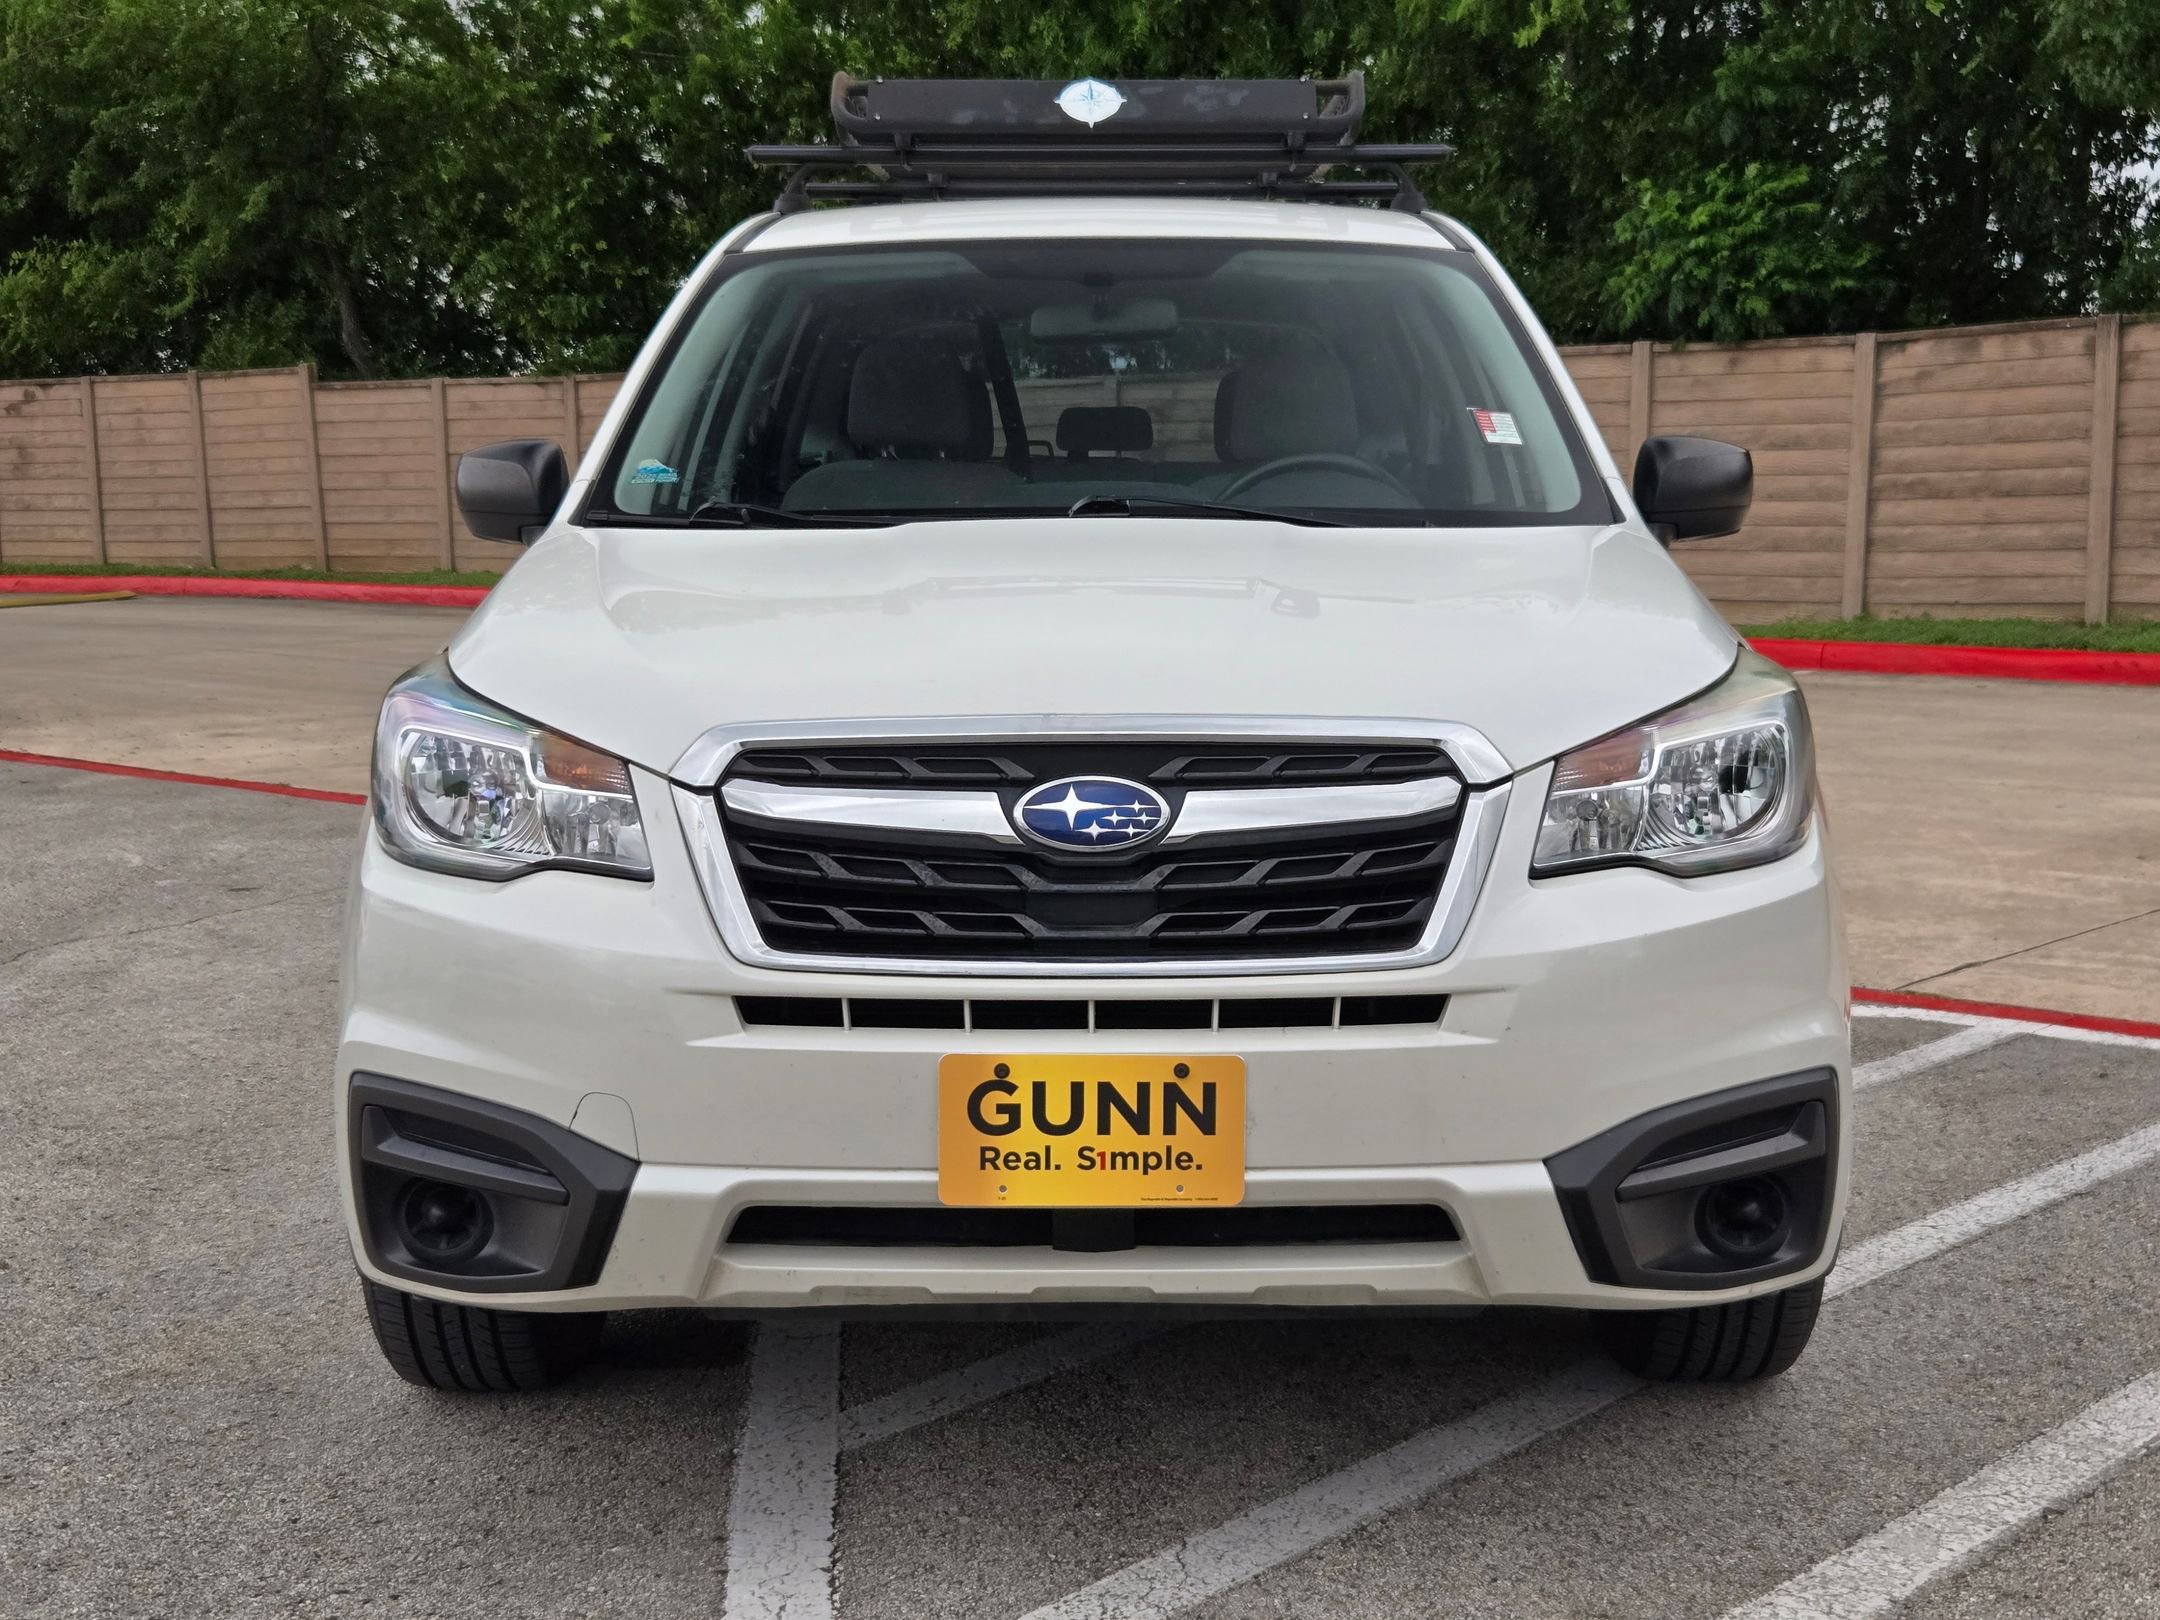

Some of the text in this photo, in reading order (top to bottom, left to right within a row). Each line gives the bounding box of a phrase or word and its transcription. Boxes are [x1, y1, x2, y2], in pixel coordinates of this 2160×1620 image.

[967, 1079, 1216, 1136] GUNN
[979, 1145, 1202, 1175] Real. S1mple.
